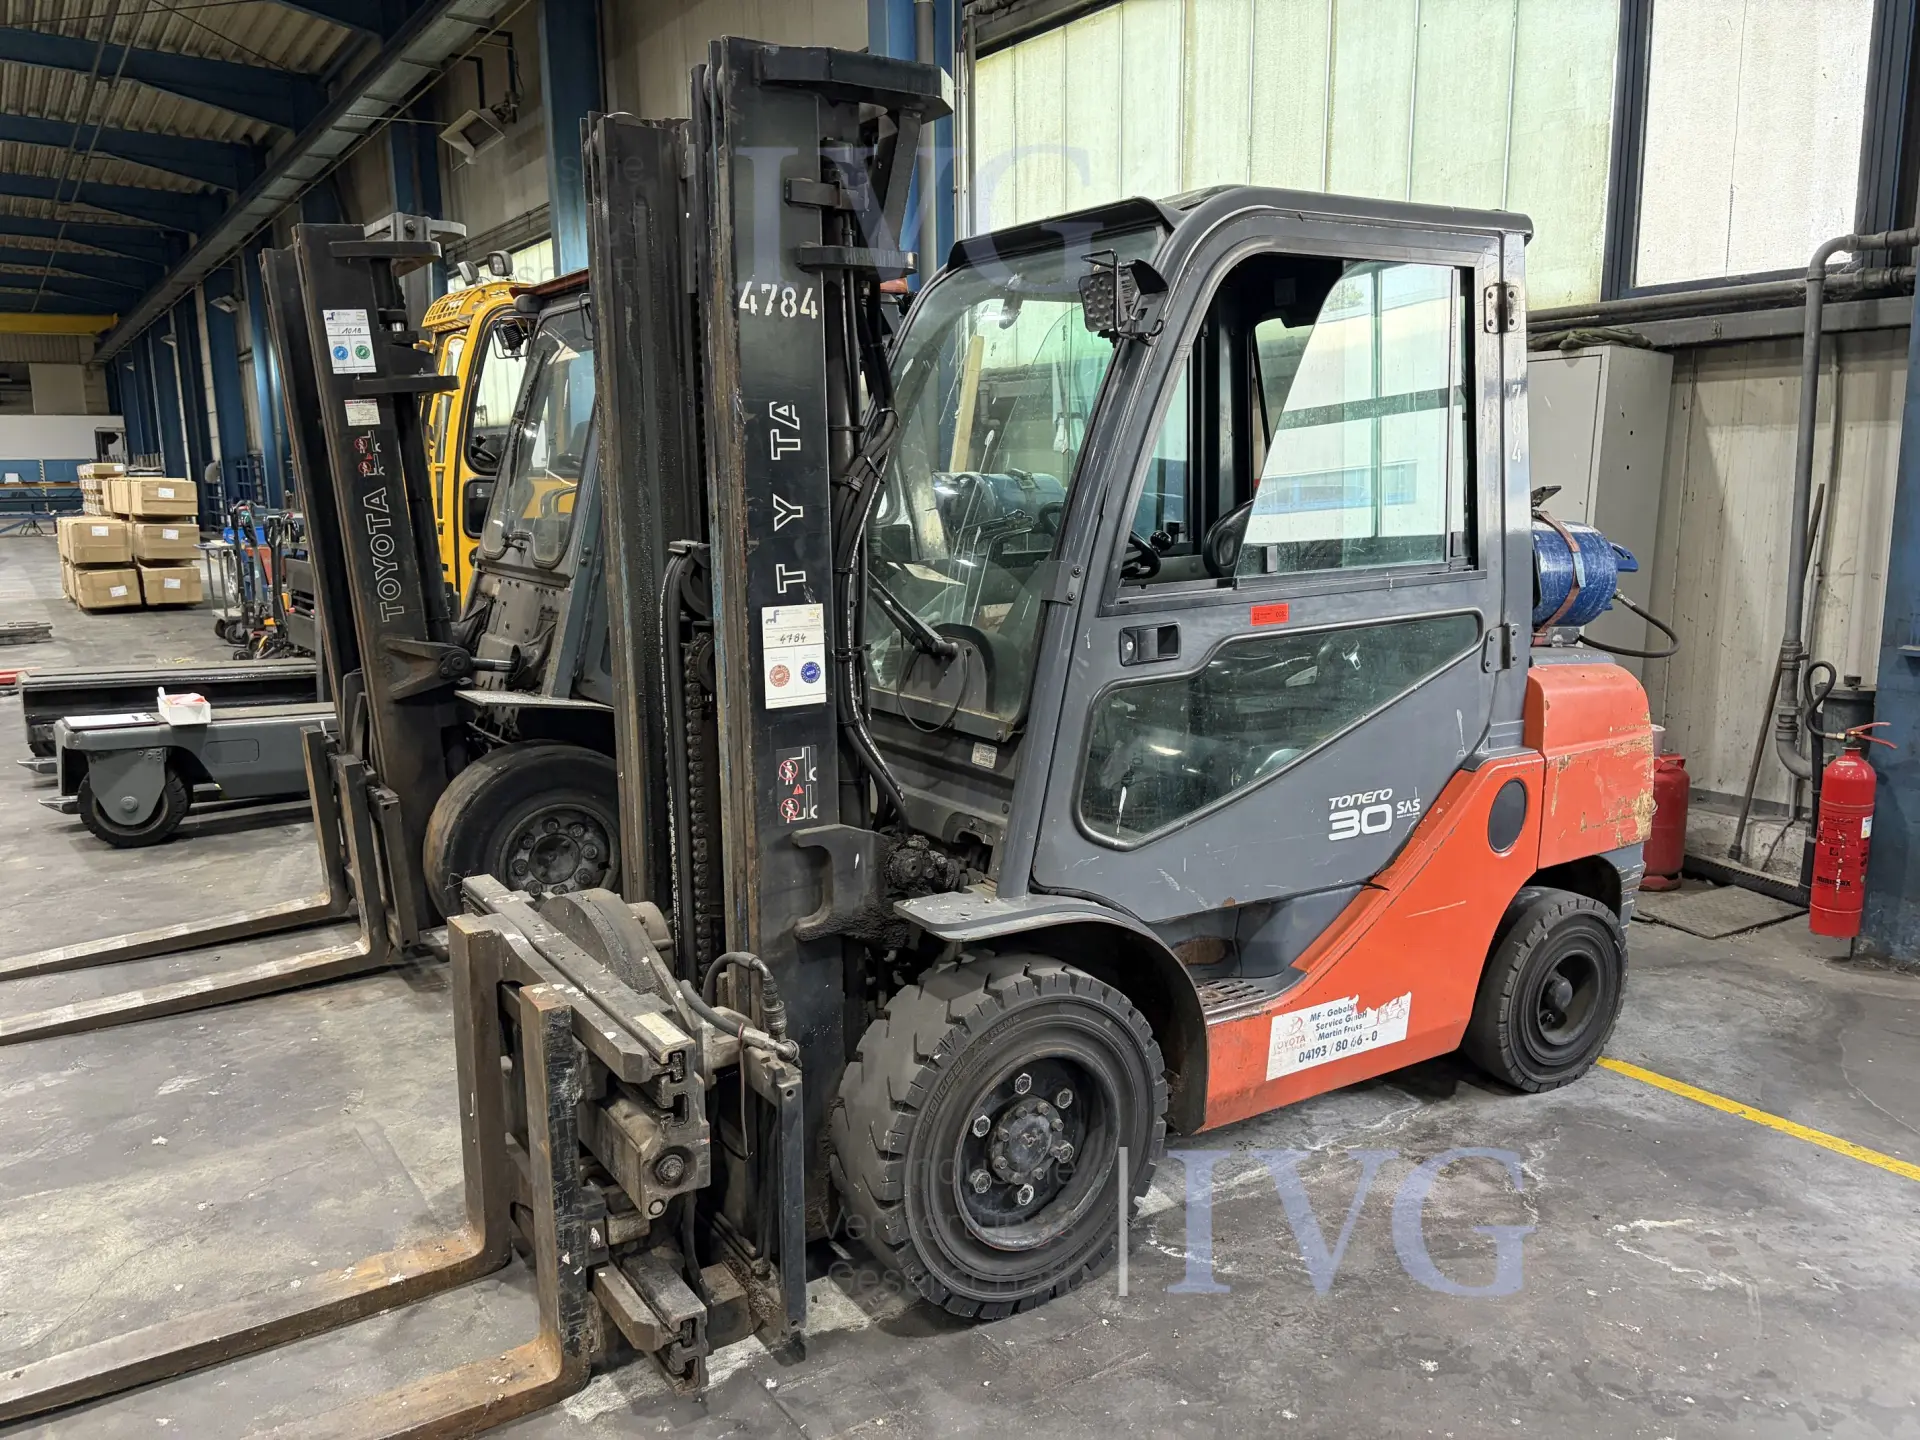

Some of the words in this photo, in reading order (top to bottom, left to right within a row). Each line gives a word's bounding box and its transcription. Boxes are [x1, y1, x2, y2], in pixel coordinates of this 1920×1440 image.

[739, 281, 818, 319] 4784
[363, 486, 404, 623] TOYOTA
[1328, 803, 1393, 841] 30
[1396, 798, 1421, 815] SAS
[1310, 1012, 1321, 1022] MF
[1315, 1018, 1343, 1031] Service
[1298, 1045, 1327, 1063] 04193
[1335, 1038, 1348, 1052] 80
[1371, 1030, 1378, 1042] 0
[1317, 1028, 1342, 1041] Martin
